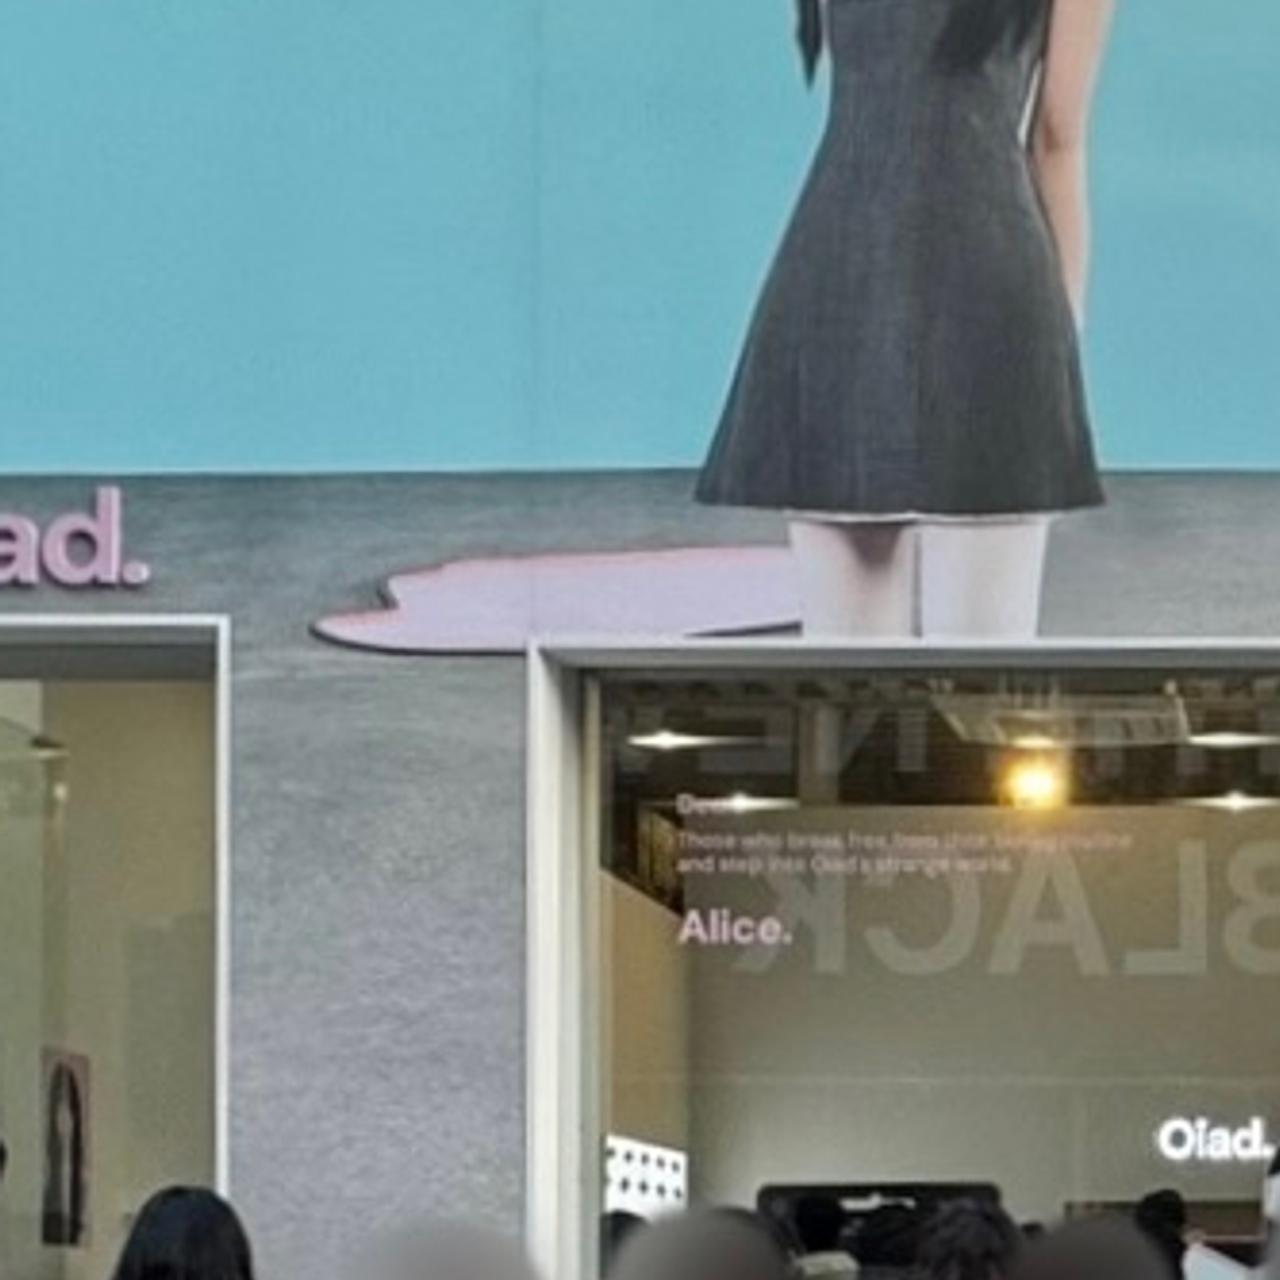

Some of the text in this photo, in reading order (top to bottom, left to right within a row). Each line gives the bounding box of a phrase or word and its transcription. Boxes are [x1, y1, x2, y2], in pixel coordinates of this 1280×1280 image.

[0, 485, 150, 586] ad.
[678, 909, 793, 946] Alice.
[1158, 1118, 1274, 1160] Oiad.
